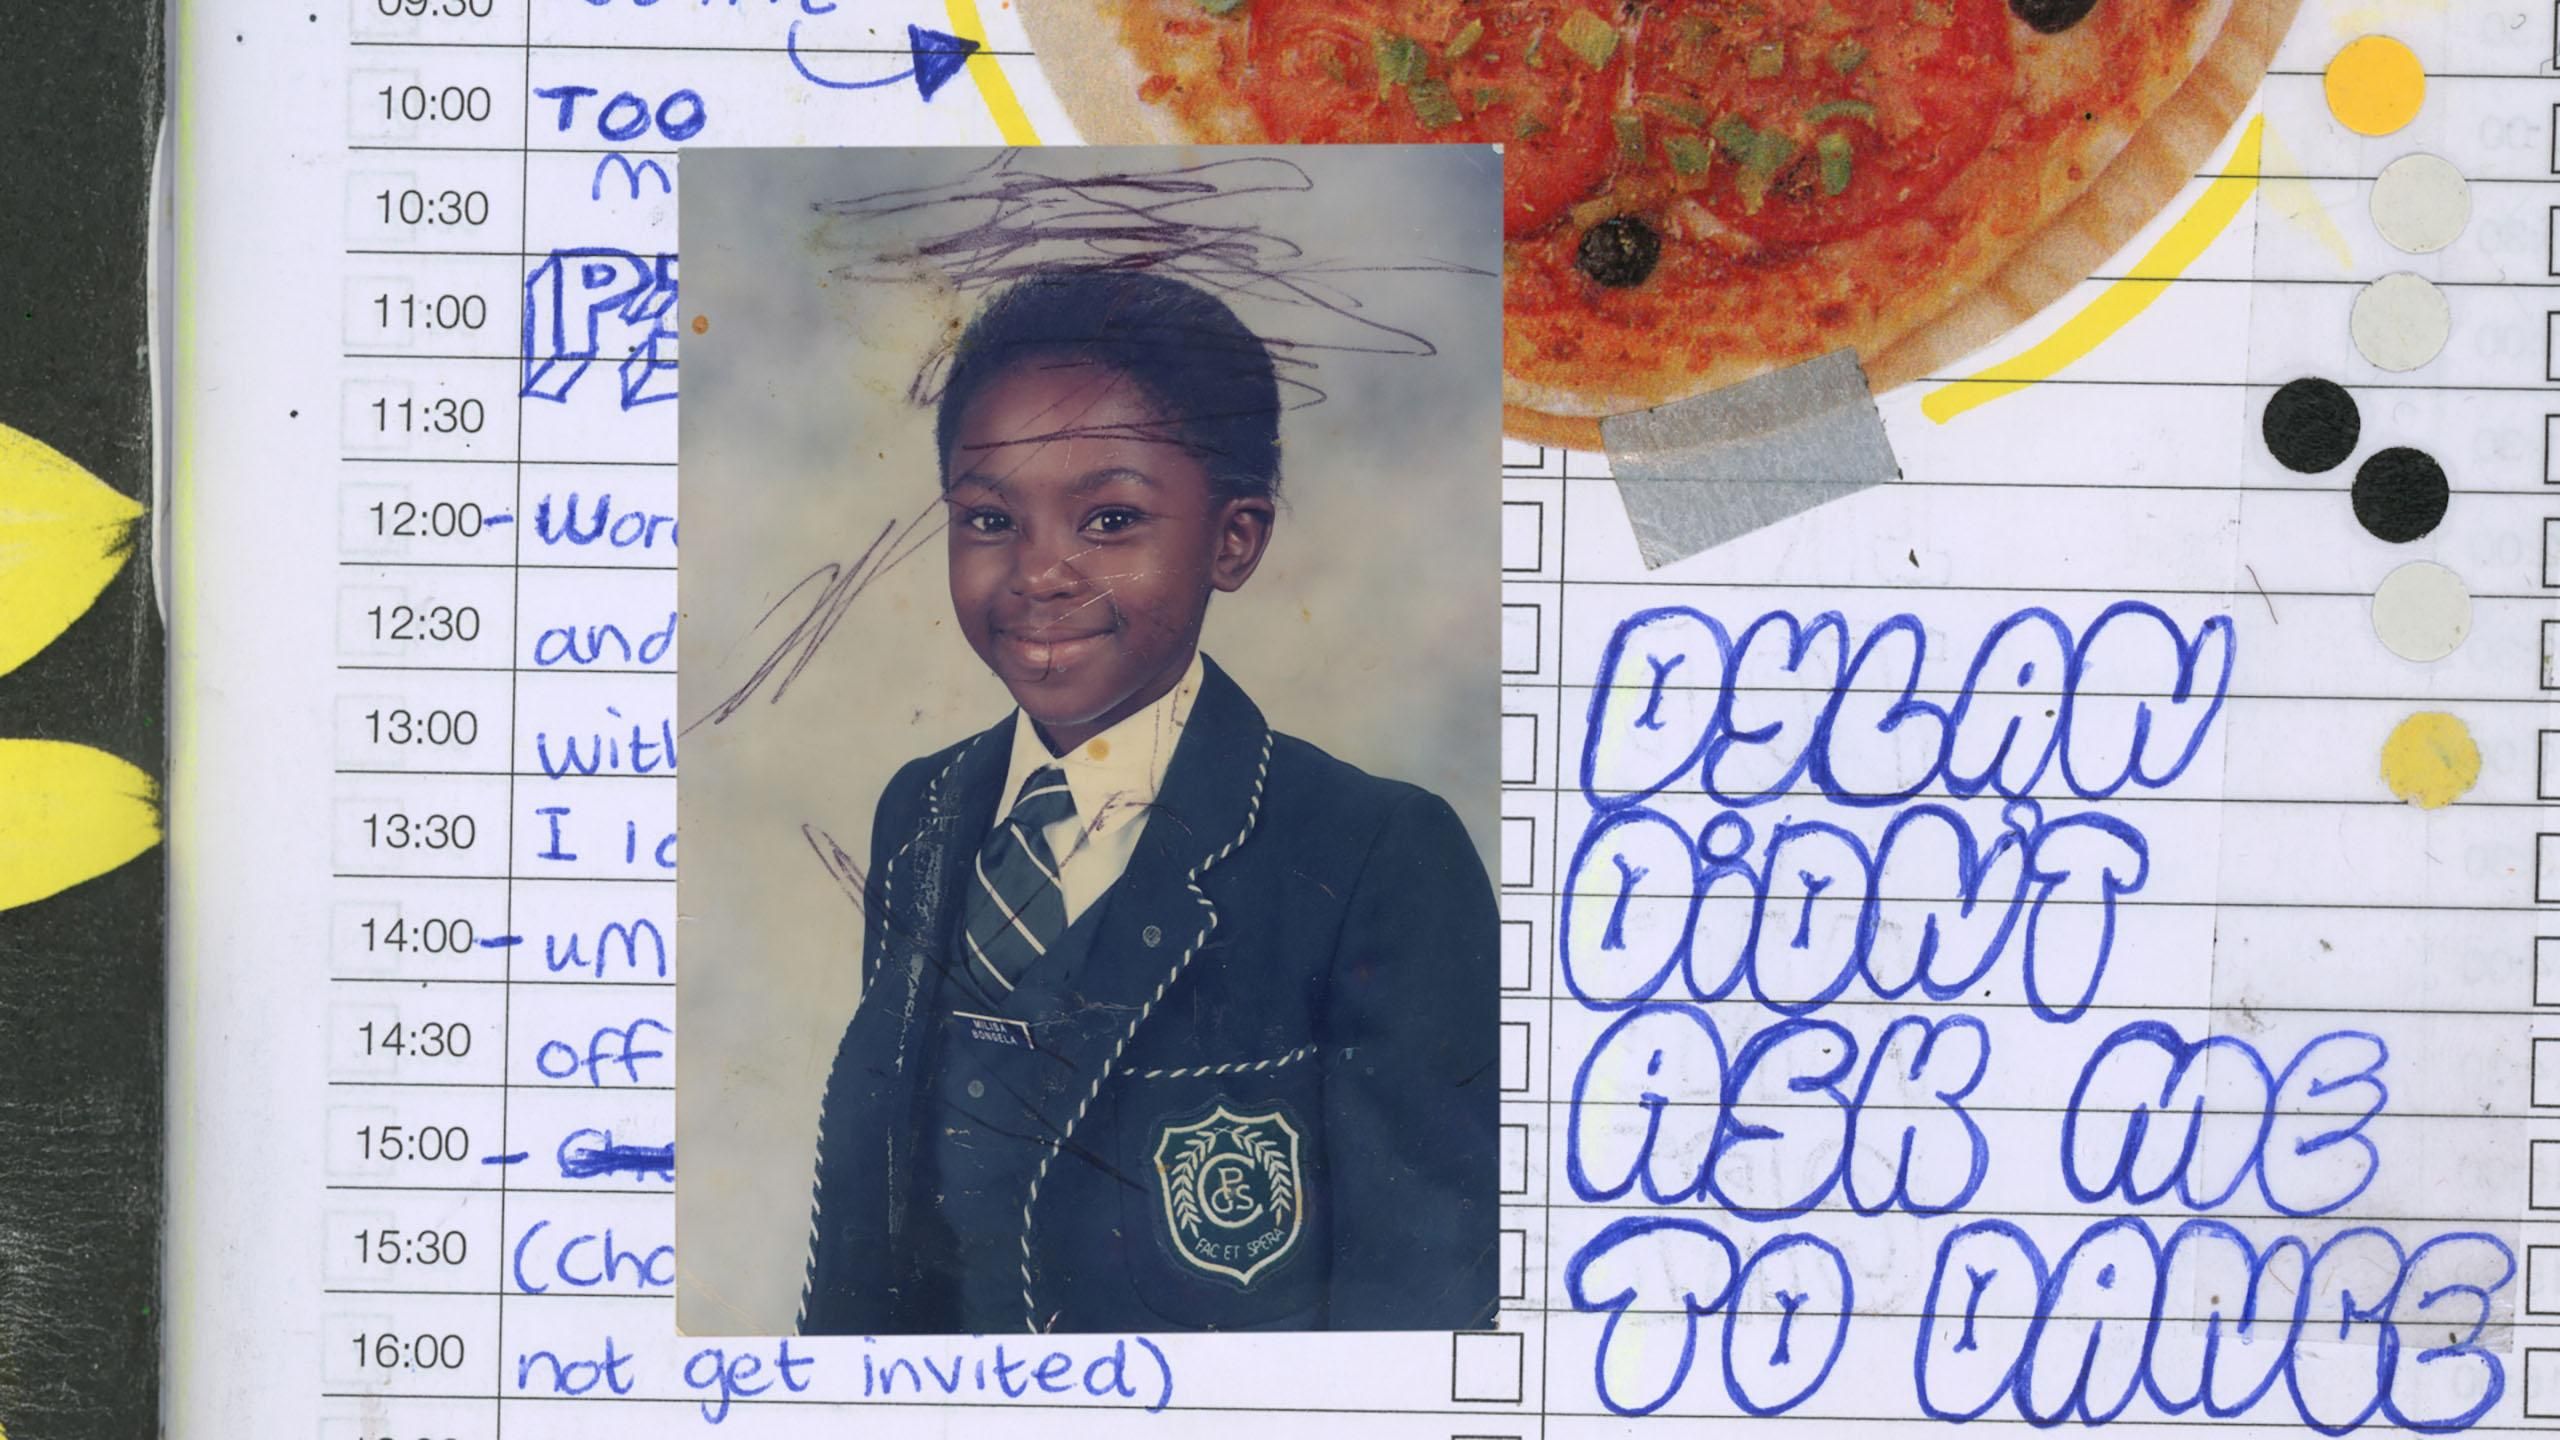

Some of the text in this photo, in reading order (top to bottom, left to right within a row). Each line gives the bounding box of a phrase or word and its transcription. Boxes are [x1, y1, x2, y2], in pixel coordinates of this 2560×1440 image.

[379, 85, 491, 121] 10:00
[535, 85, 707, 142] TOO
[376, 190, 489, 225] 10:30
[374, 294, 486, 329] 11:00
[372, 398, 484, 433] 11:30
[370, 502, 482, 537] 12:00
[534, 492, 678, 549] Wor
[368, 606, 480, 641] 12:30
[534, 611, 678, 666] and
[1580, 600, 2237, 808] DYLAN
[366, 709, 477, 745] 13:00
[363, 814, 475, 849] 13:30
[535, 806, 578, 861] I
[361, 918, 473, 953] 14:00
[358, 1022, 471, 1057] 14:30
[536, 1018, 674, 1089] off
[1566, 1001, 2390, 1222] ASK ME
[356, 1126, 469, 1161] 15:00
[354, 1230, 467, 1265] 15:30
[1195, 1227, 1285, 1261] FAC ET SPERA
[1564, 1214, 2517, 1437] TO DANCE
[352, 1333, 464, 1369] 16:00
[518, 1336, 1174, 1425] not get invited)
